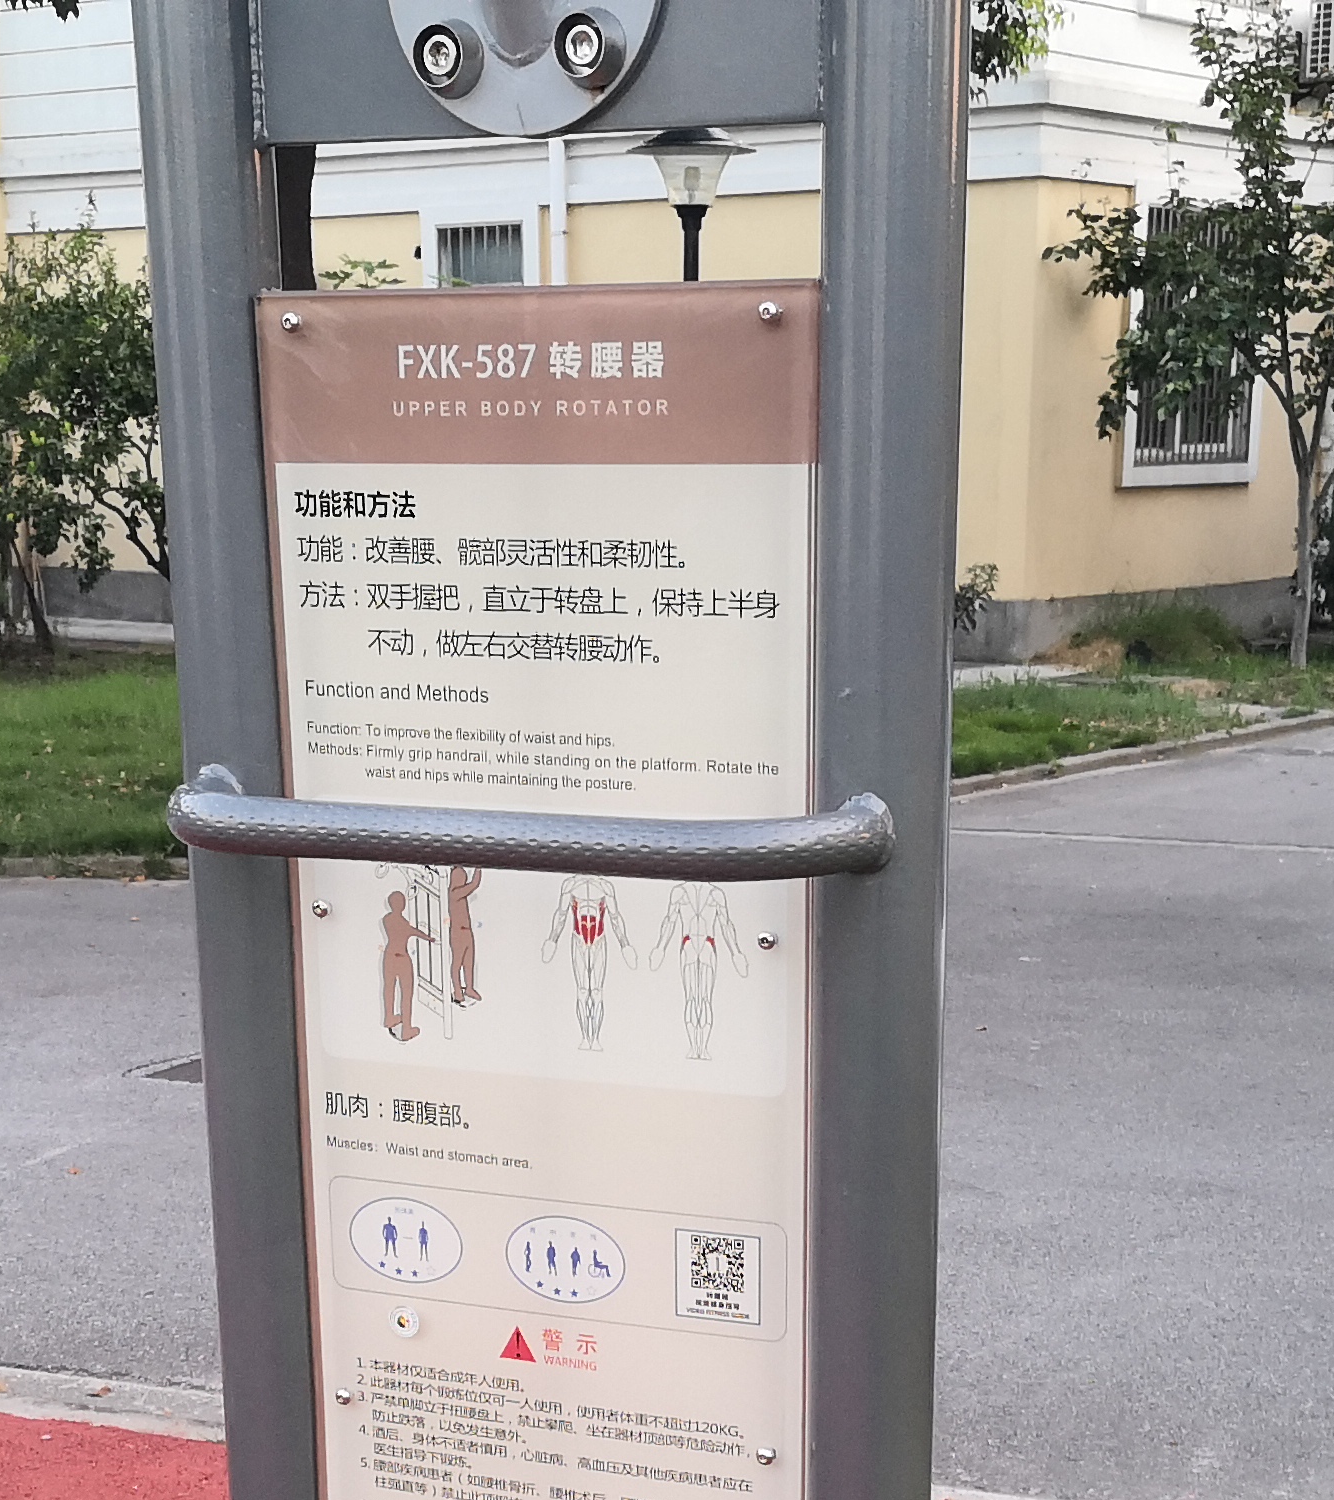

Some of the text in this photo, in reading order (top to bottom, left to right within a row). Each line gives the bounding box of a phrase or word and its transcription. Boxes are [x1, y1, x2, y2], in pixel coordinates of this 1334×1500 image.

[396, 341, 665, 380] FXK-587 转腰器
[392, 398, 670, 418] UPPER BODY ROTATOR
[294, 490, 417, 519] 功能和方法
[305, 679, 488, 703] Function and Methods
[365, 723, 380, 736] To
[383, 724, 430, 741] improve
[433, 727, 452, 740] the
[455, 727, 505, 745] flexibility
[508, 730, 521, 743] of
[523, 731, 555, 744] waist
[558, 733, 581, 745] and
[366, 744, 404, 761] Firmly
[408, 747, 432, 762] grip
[495, 750, 529, 764] while
[533, 753, 589, 770] standing
[594, 757, 610, 768] on
[615, 755, 636, 769] the
[706, 759, 752, 774] Rotate
[757, 761, 779, 775] the
[364, 765, 395, 778] waist
[398, 767, 421, 780] and
[424, 768, 449, 783] hips
[452, 769, 483, 783] while
[487, 771, 557, 790] maintaining
[561, 774, 581, 788] the
[325, 1091, 470, 1130] 肌肉：腰腹部。
[543, 1354, 598, 1371] WARNING
